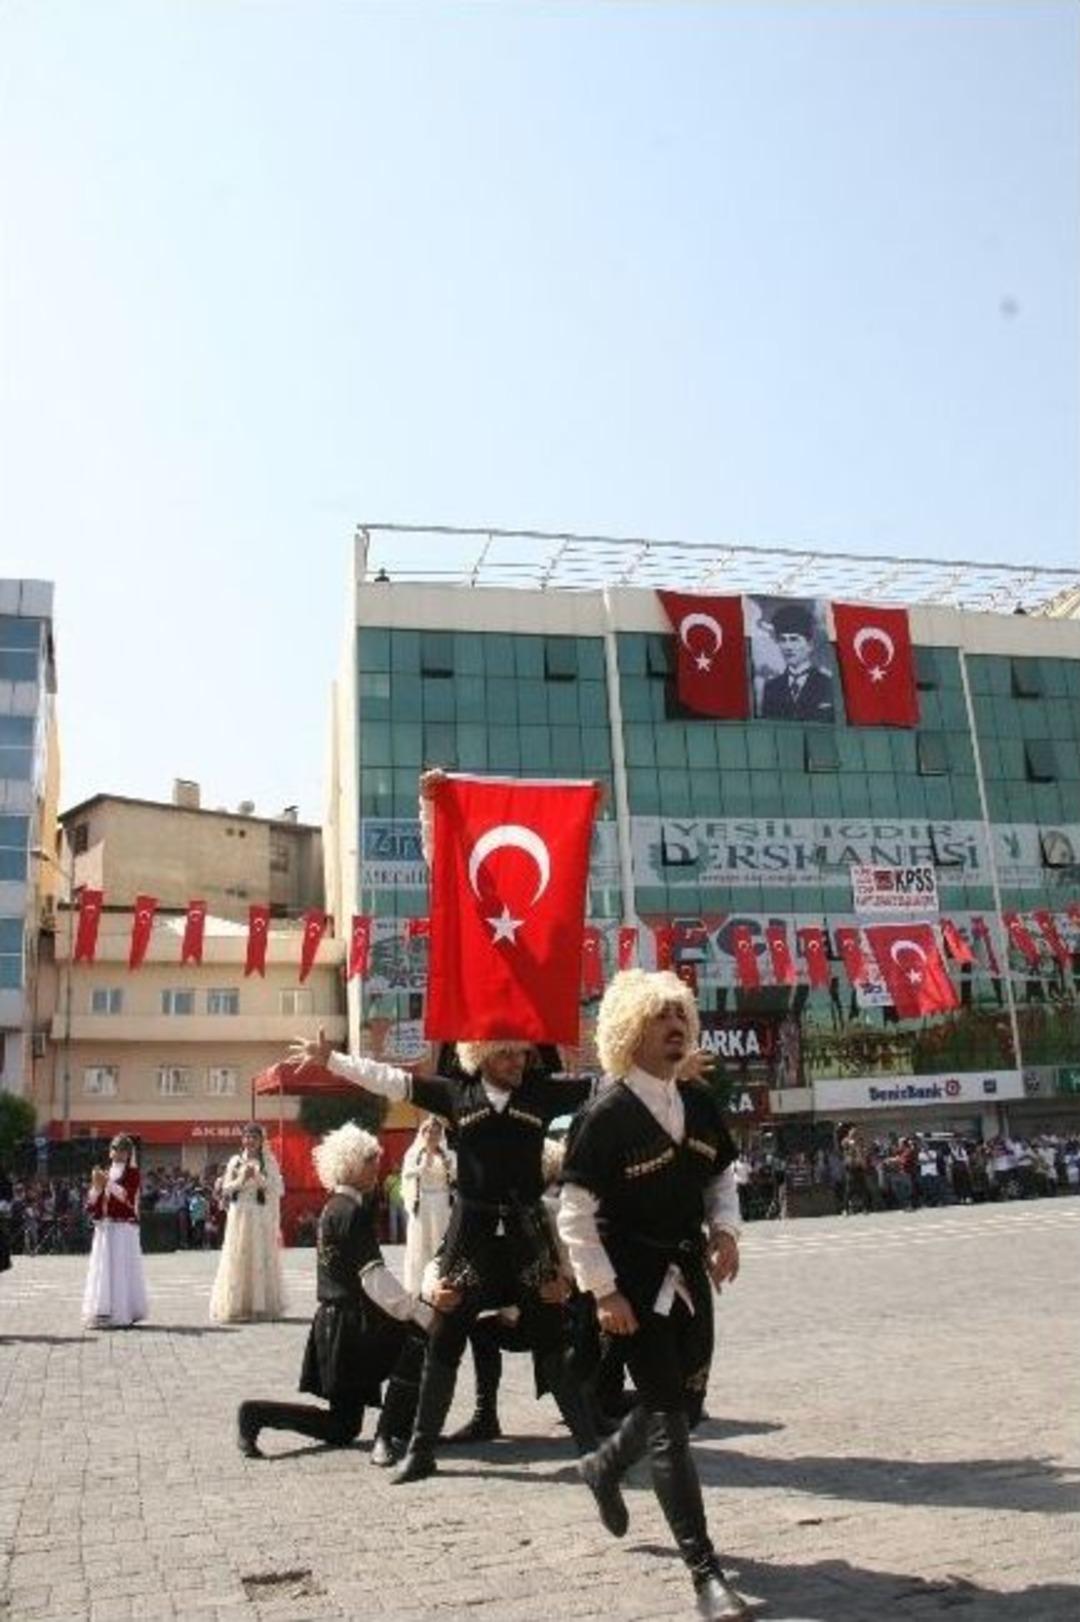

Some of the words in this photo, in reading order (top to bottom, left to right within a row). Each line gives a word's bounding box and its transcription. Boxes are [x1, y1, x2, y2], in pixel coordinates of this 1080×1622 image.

[895, 867, 935, 894] KPSS
[700, 1029, 761, 1056] ARKA
[868, 1082, 944, 1101] DenizBank
